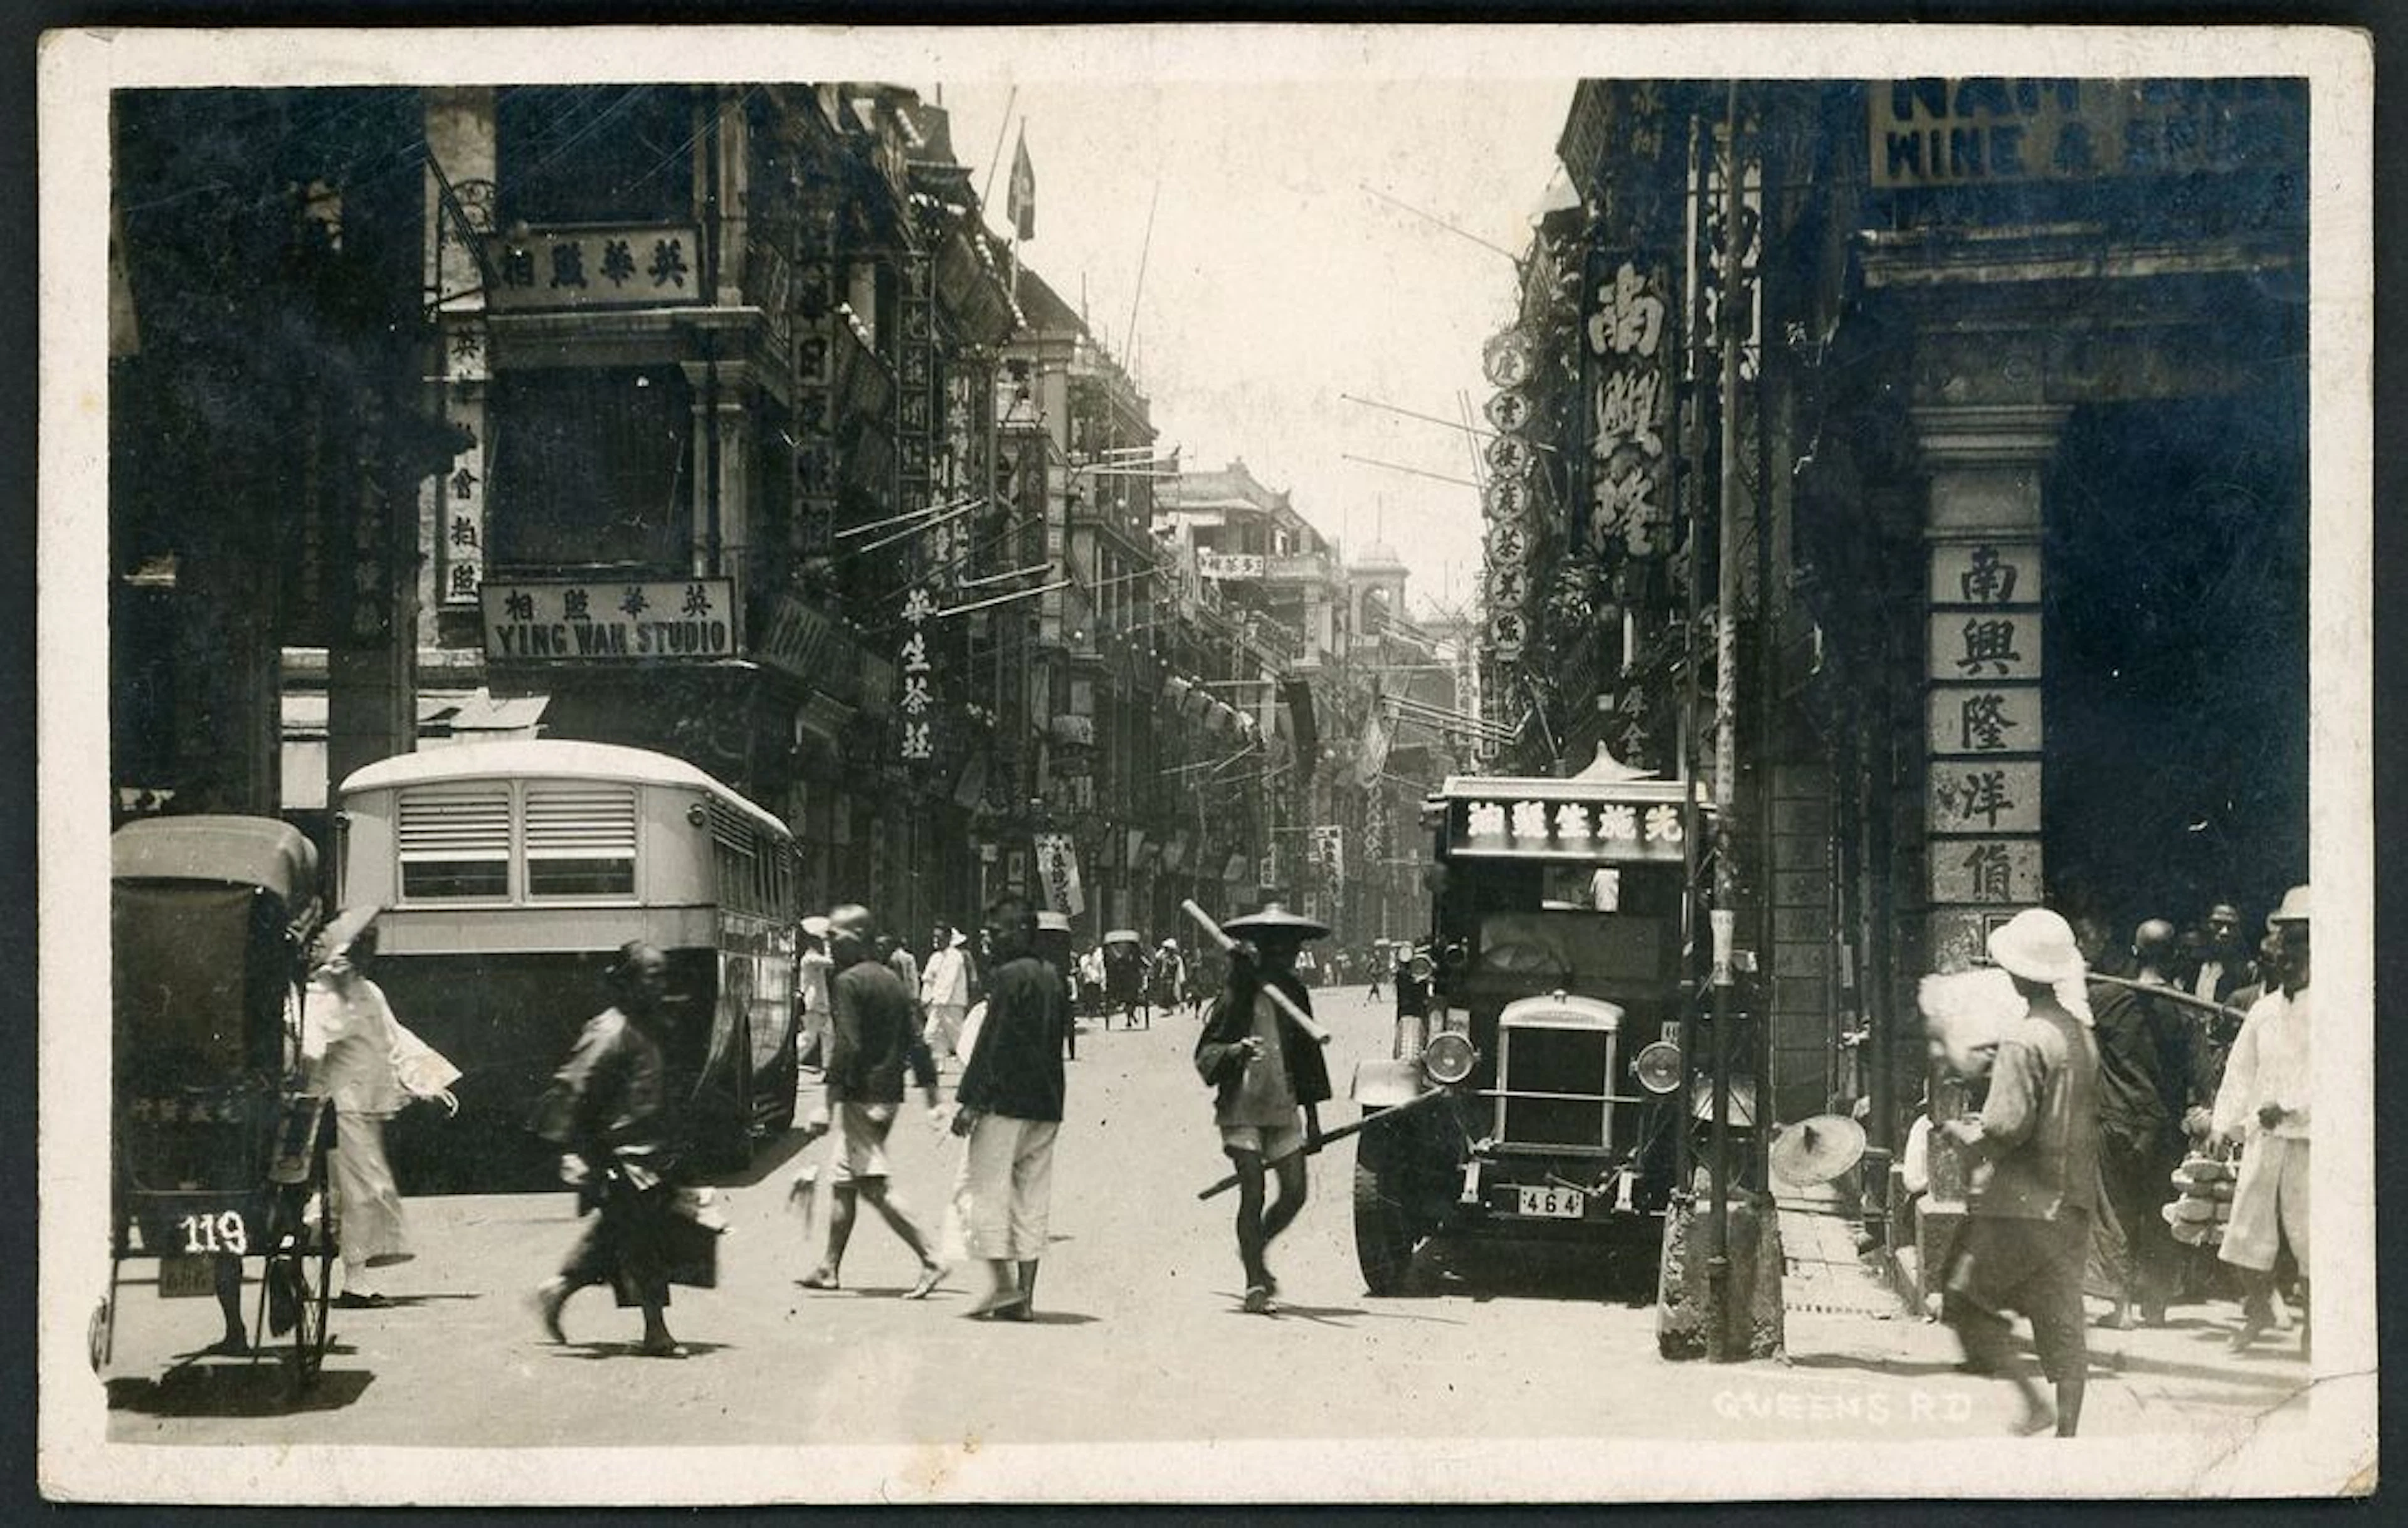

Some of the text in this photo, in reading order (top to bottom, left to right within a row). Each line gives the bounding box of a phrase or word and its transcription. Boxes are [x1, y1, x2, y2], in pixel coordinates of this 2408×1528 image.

[1886, 125, 2025, 179] WINE
[496, 623, 568, 656] YING
[636, 621, 725, 653] STUDIO
[1528, 1193, 1575, 1214] 464
[178, 1210, 248, 1255] 119
